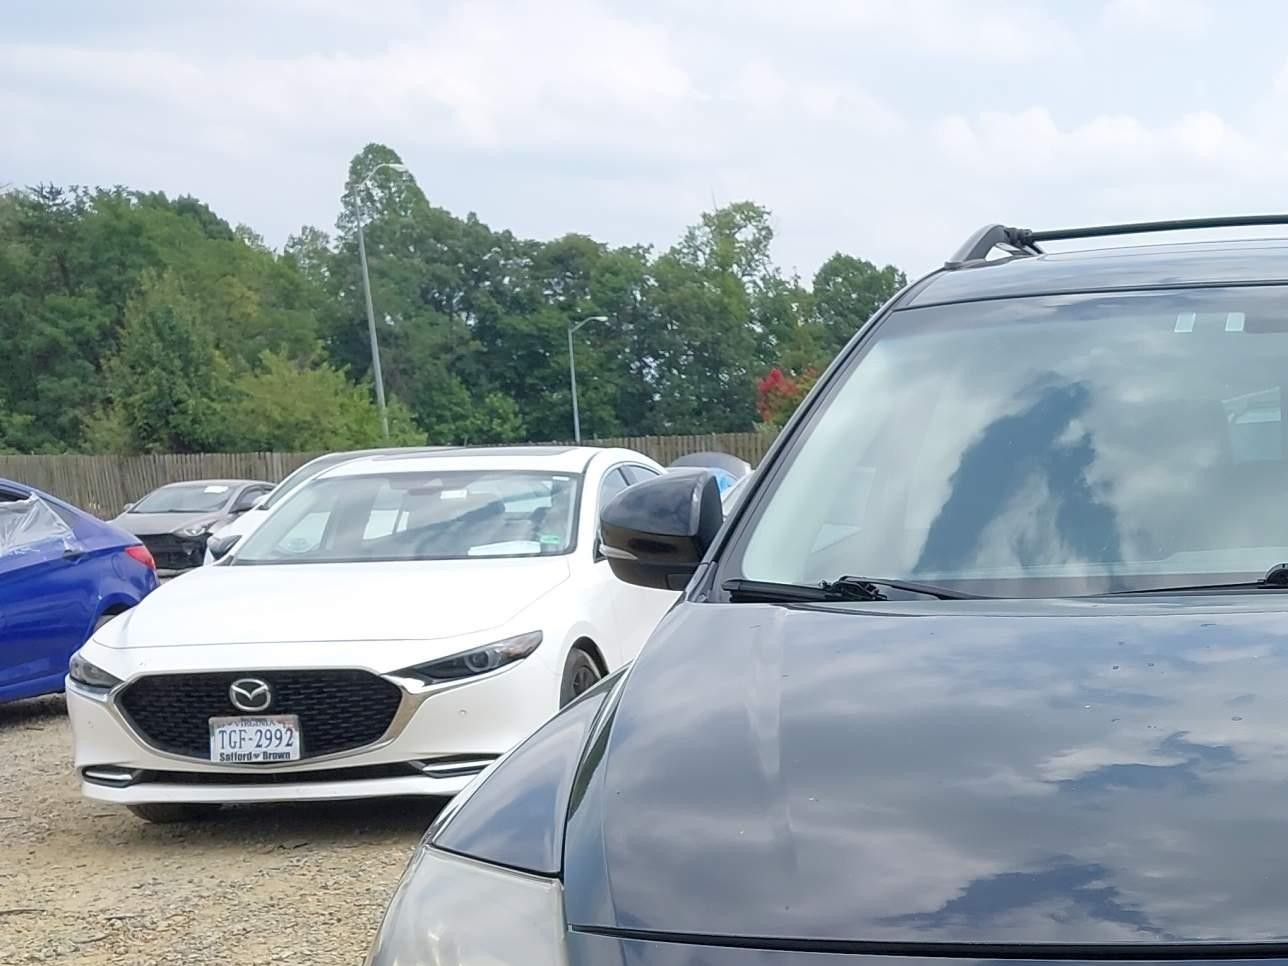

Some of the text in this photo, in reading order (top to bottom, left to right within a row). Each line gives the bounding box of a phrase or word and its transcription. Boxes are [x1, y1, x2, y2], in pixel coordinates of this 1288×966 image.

[234, 718, 276, 728] VIRGINIA
[218, 728, 294, 749] TGF-2992
[262, 751, 291, 761] Brown
